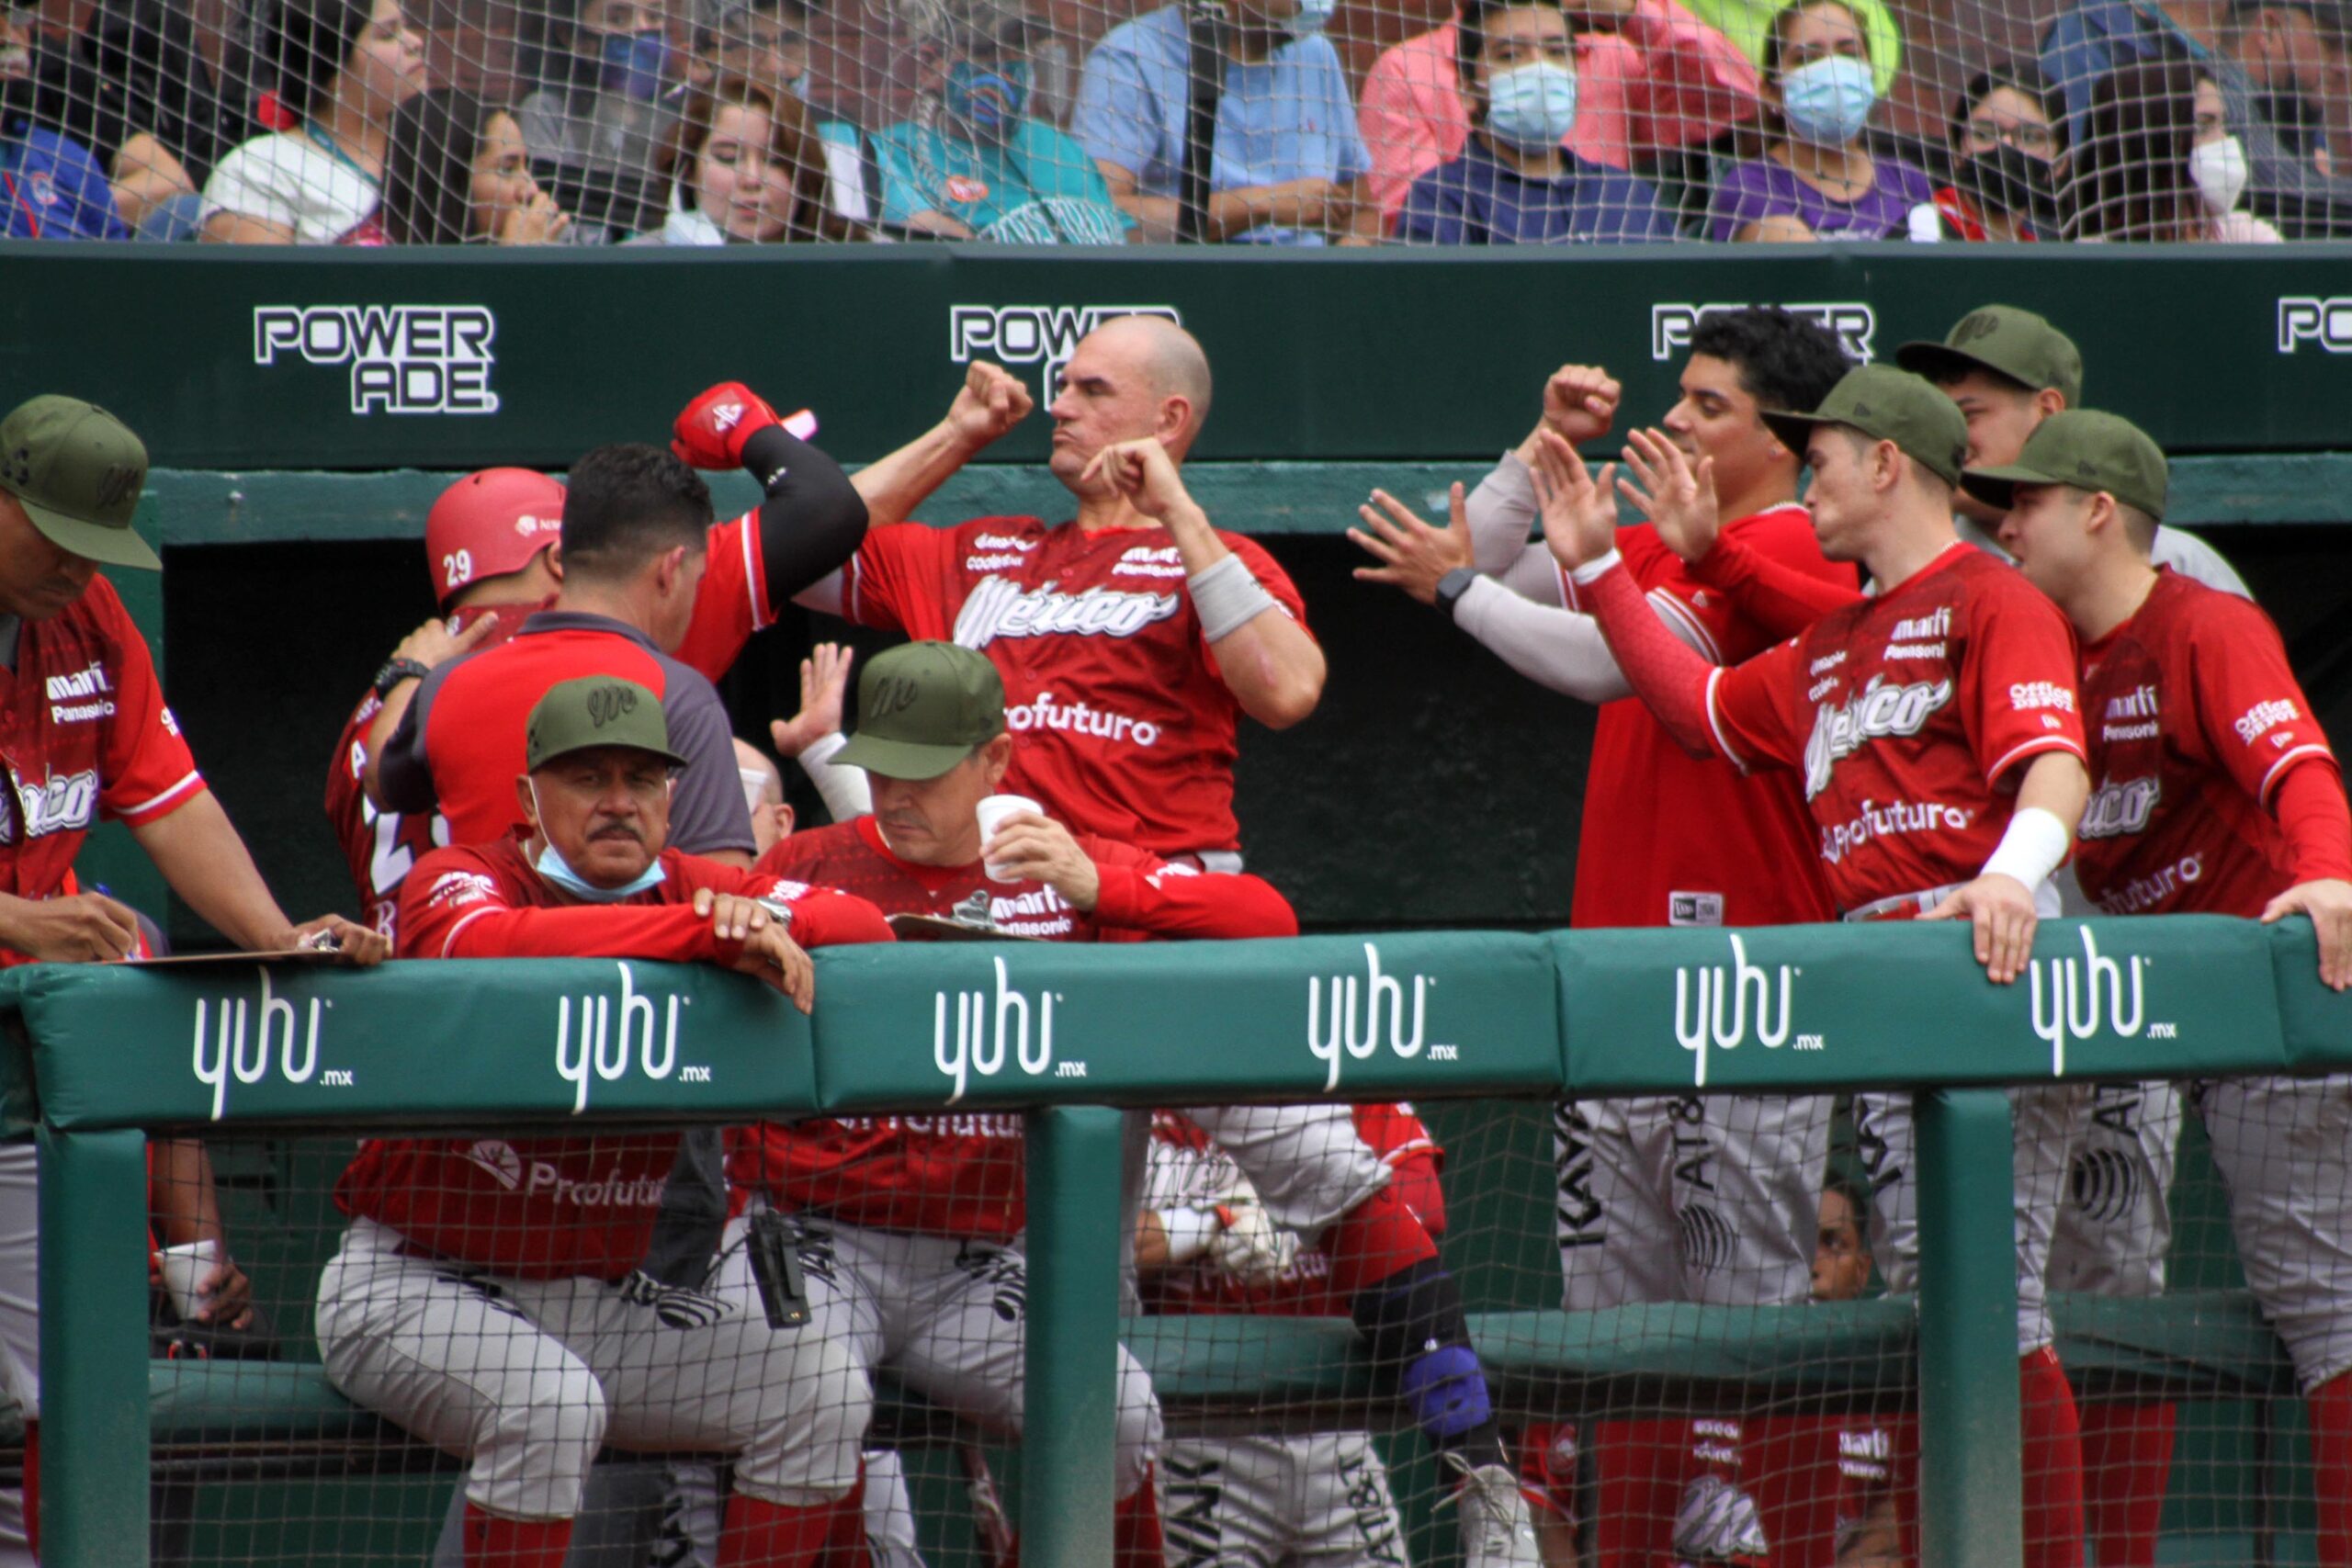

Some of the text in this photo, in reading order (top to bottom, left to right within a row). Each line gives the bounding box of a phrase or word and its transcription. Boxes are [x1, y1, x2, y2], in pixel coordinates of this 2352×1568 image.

[254, 306, 494, 364] POWER
[950, 305, 1182, 363] POW
[443, 548, 472, 588] 29
[952, 573, 1180, 651] México
[1002, 691, 1159, 747] ofuturo
